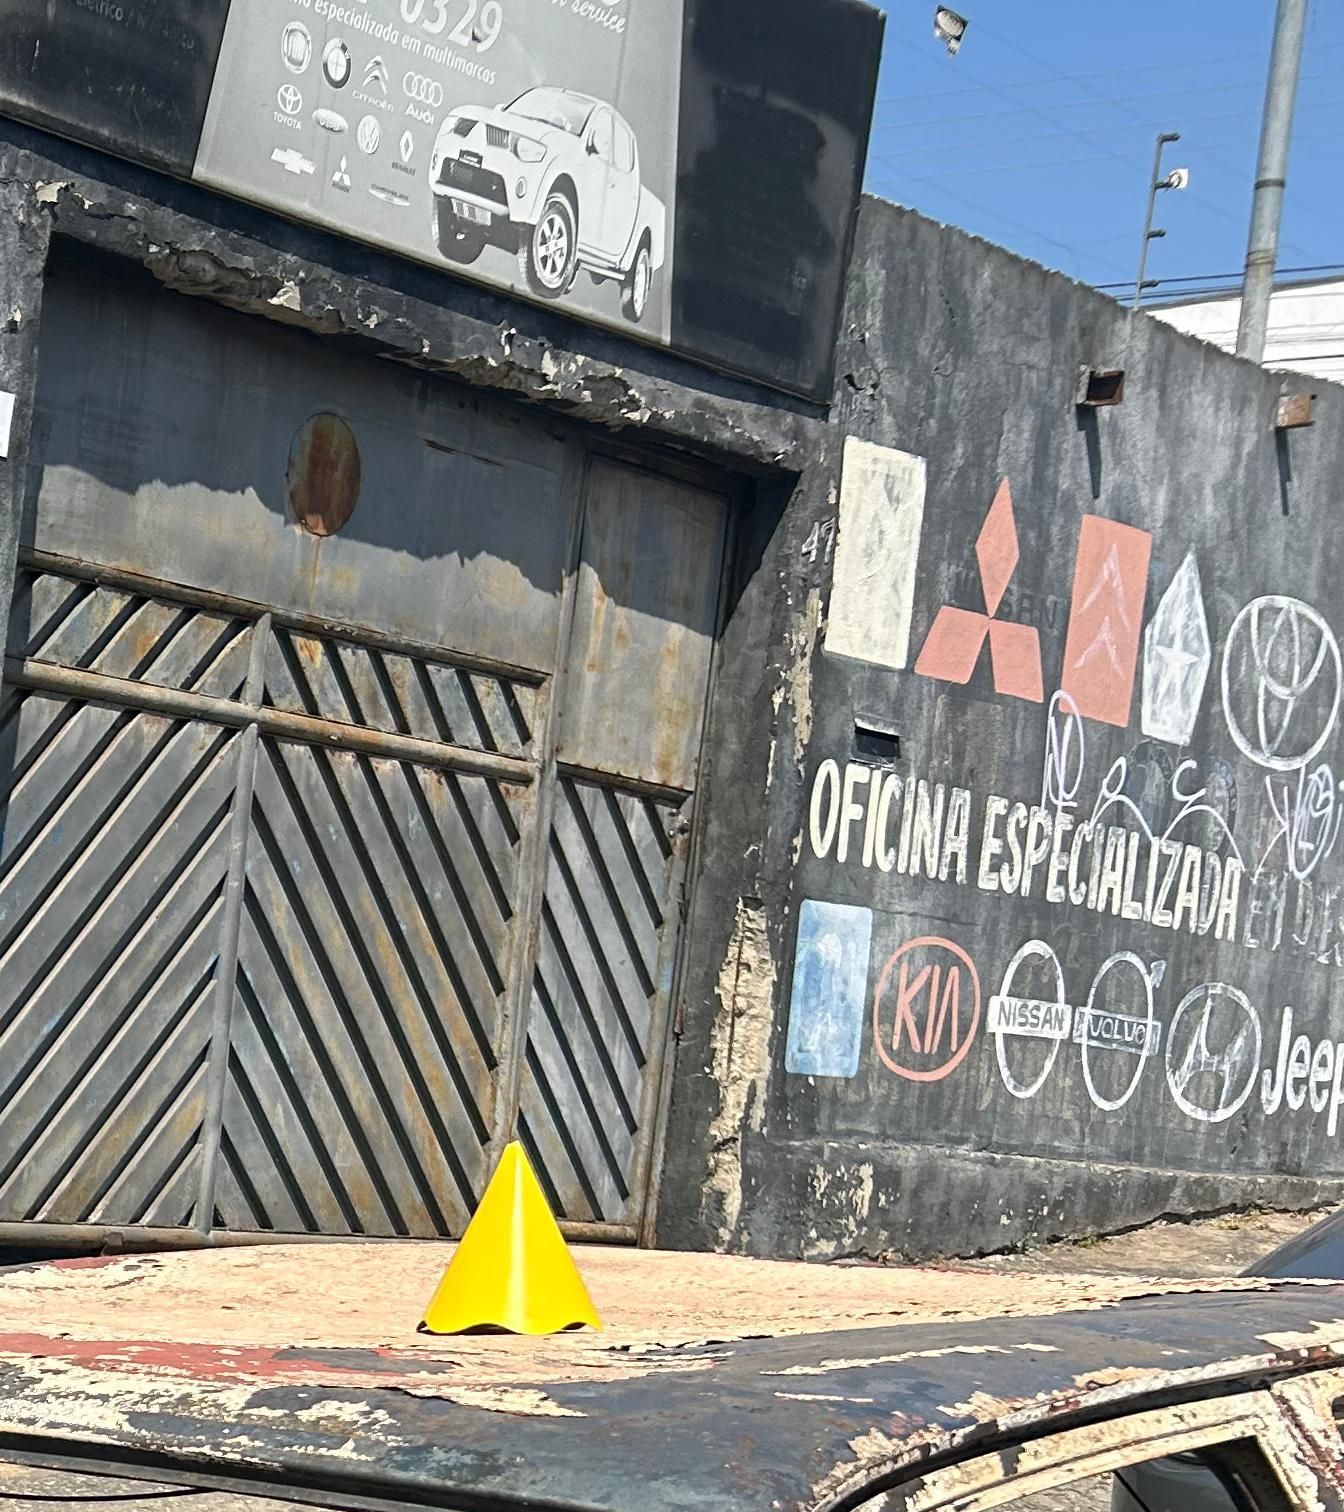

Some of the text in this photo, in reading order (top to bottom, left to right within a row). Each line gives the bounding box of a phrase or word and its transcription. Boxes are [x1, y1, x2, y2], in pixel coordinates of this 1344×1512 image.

[314, 0, 497, 86] especializada em multimarcas
[272, 112, 302, 131] TOYOTA
[810, 759, 969, 885] OFICINA
[977, 793, 1242, 942] ESPECIALIZADA
[997, 1001, 1065, 1032] NISSAN
[1087, 1013, 1147, 1045] VOLVO
[1261, 1005, 1344, 1137] Jeep
